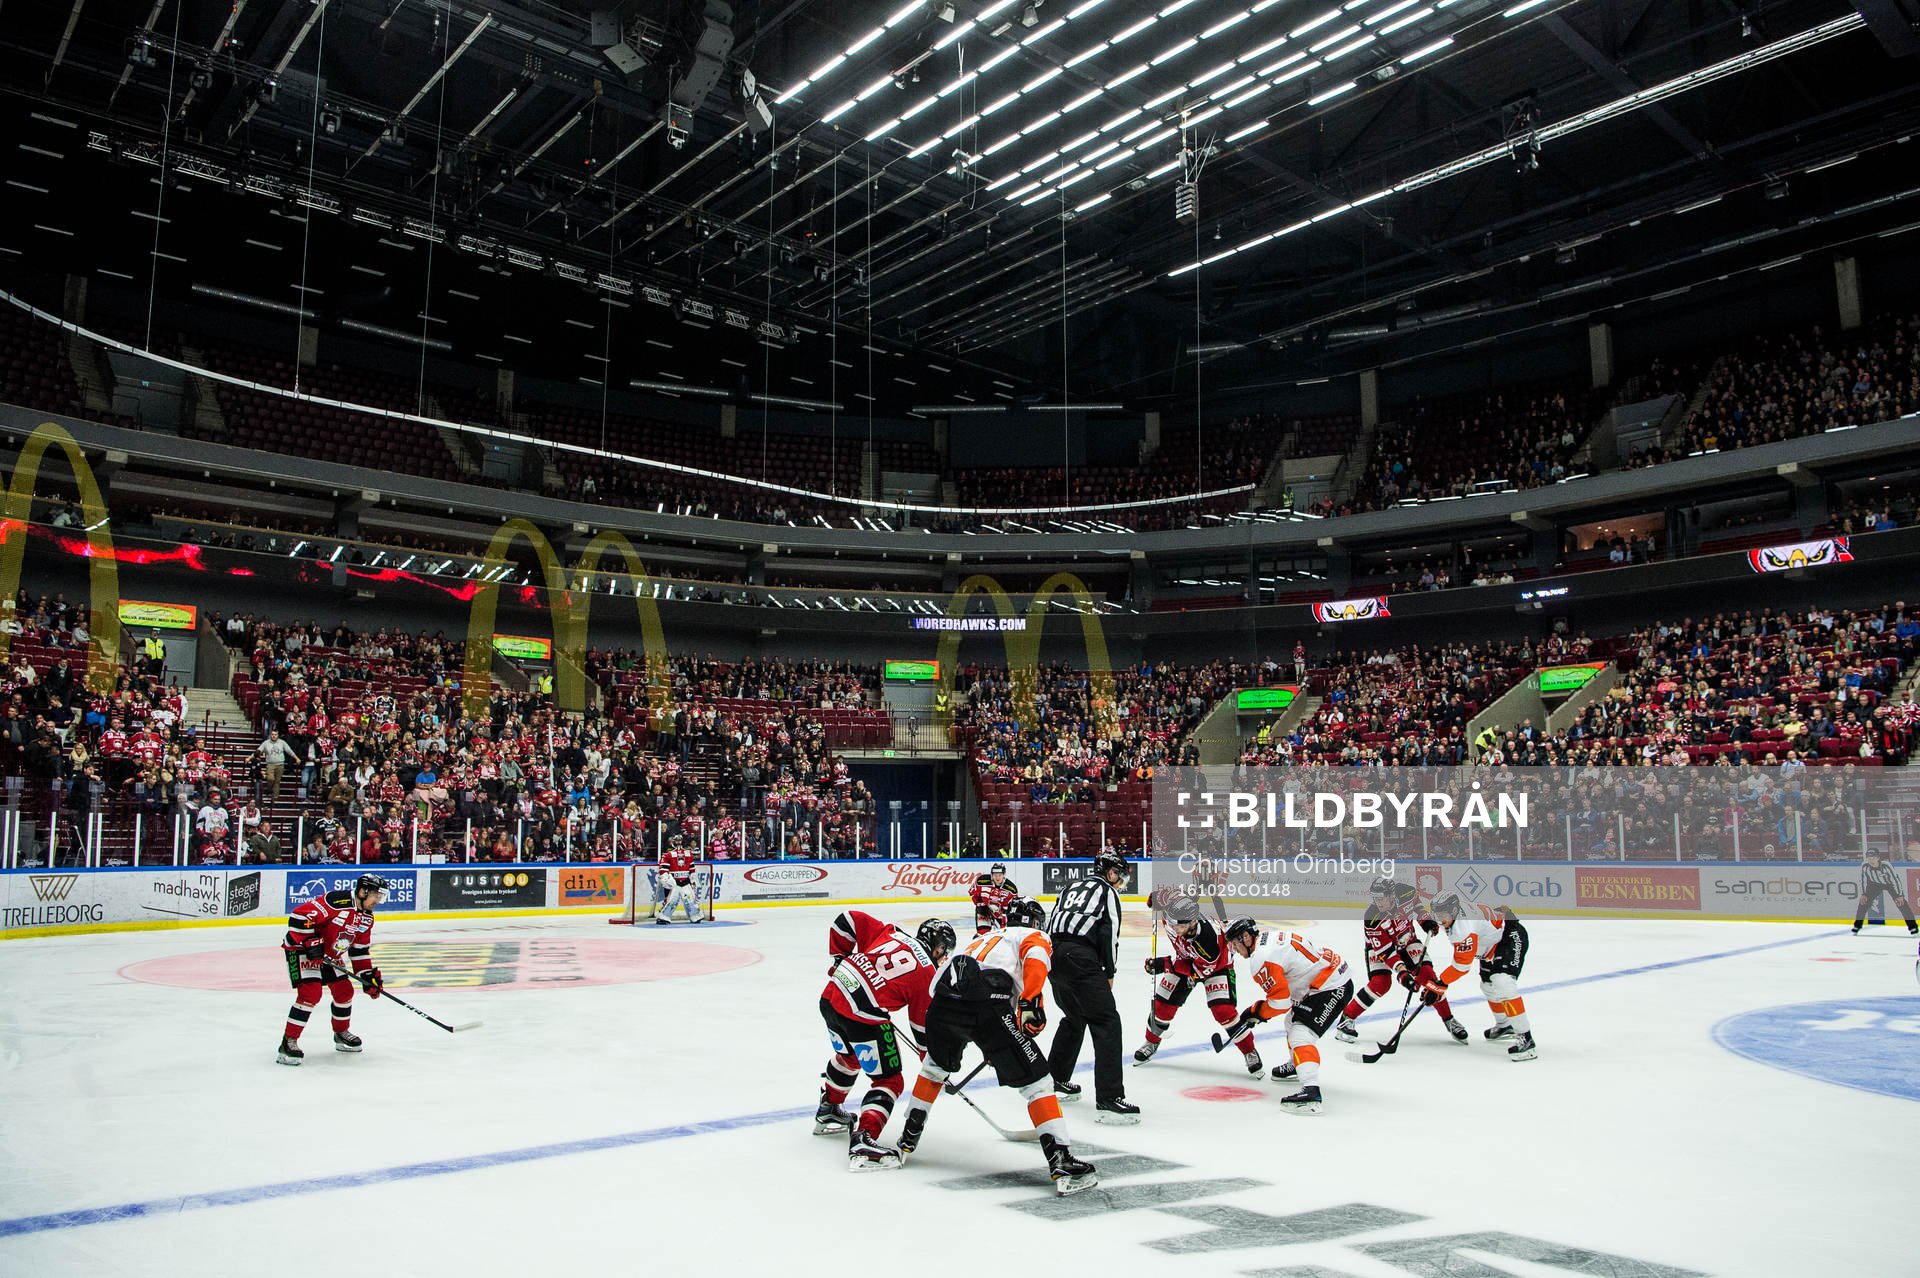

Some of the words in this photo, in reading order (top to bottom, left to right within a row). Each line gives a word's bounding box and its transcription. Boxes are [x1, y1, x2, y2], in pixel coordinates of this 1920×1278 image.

[154, 879, 221, 902] madhawk
[229, 879, 259, 899] steget
[289, 886, 310, 896] LA
[1493, 874, 1562, 897] Ocab
[1580, 883, 1696, 901] ELSNABBEN
[1715, 877, 1859, 900] sandberg
[1063, 890, 1088, 909] 84
[3, 904, 103, 926] TRELLEBORG
[1205, 982, 1229, 993] MAXI
[1021, 1040, 1039, 1064] Rock
